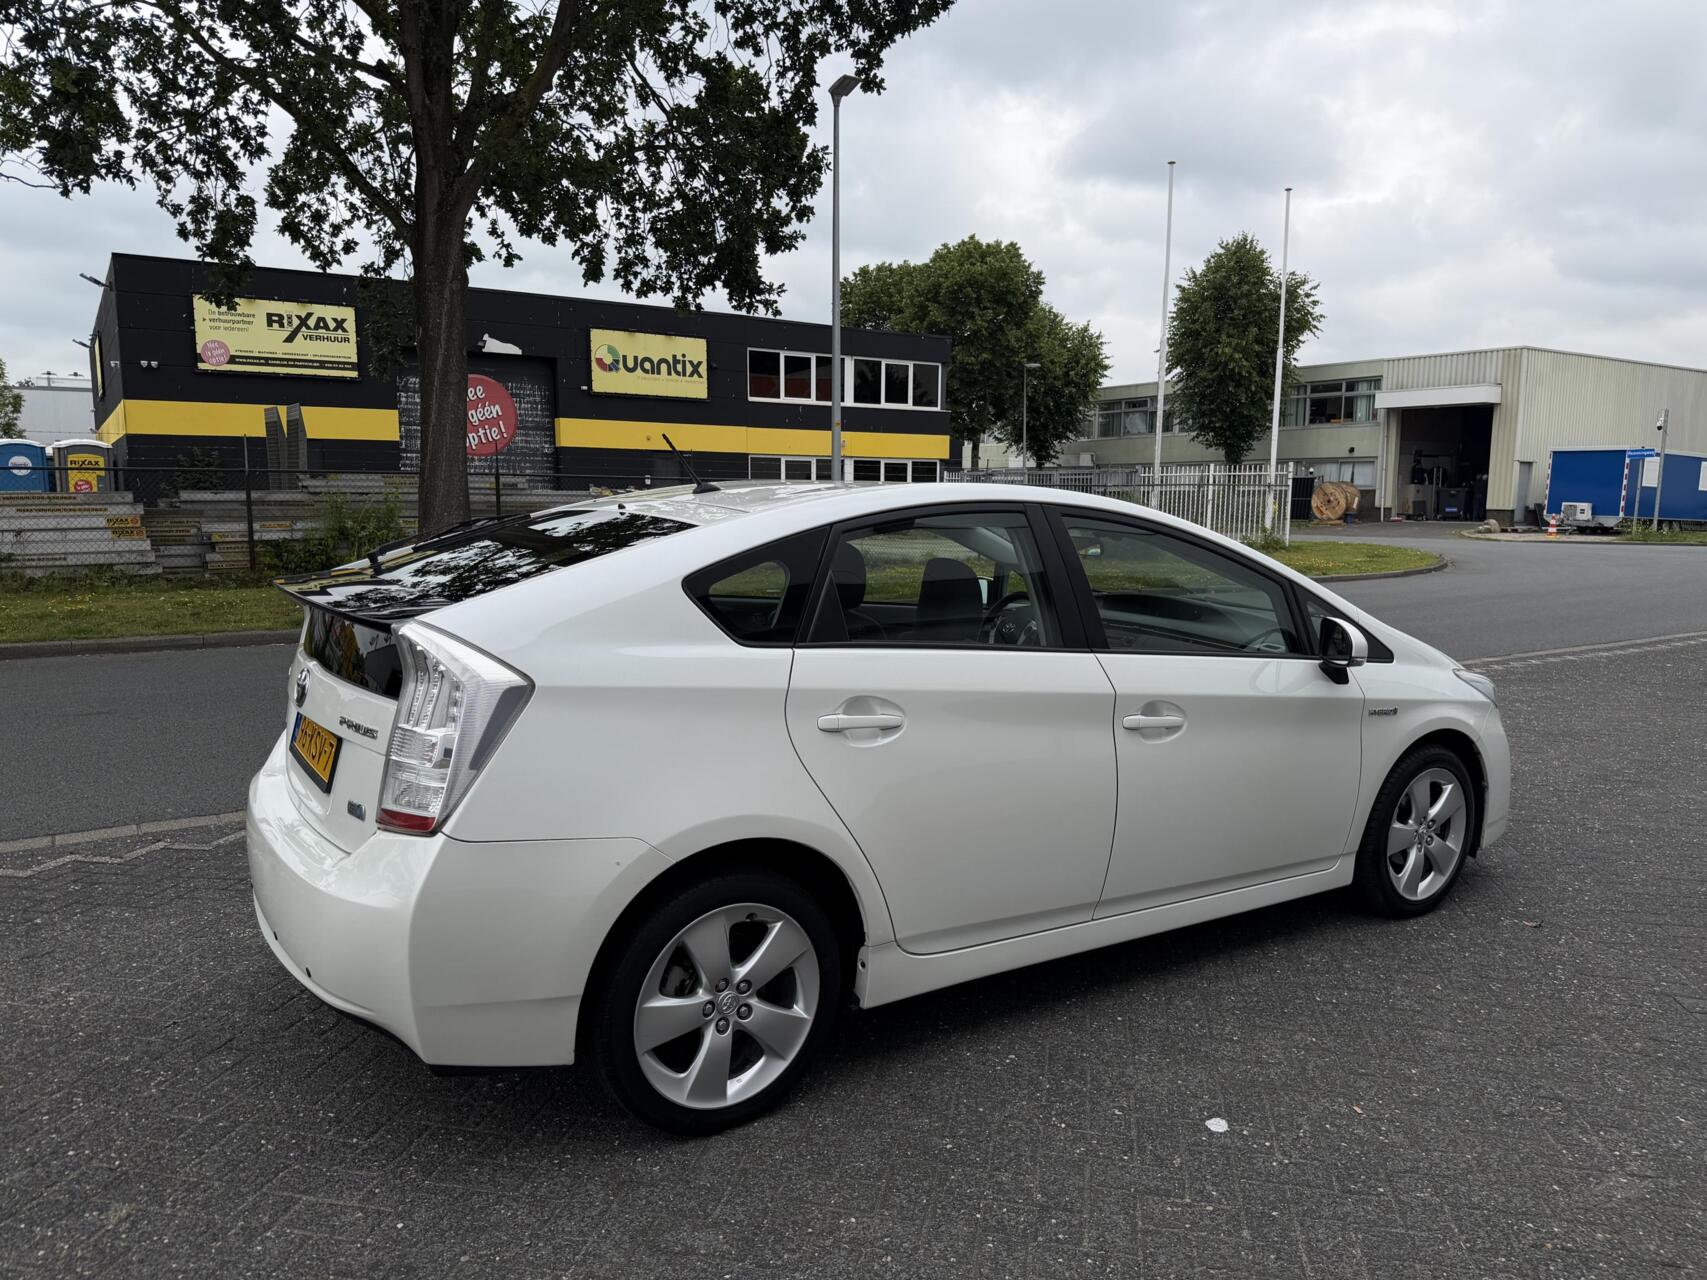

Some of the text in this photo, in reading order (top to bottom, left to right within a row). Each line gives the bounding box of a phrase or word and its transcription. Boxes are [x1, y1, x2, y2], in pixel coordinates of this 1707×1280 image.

[302, 333, 351, 344] VERHUUR
[467, 385, 486, 401] ee
[468, 401, 503, 426] géén
